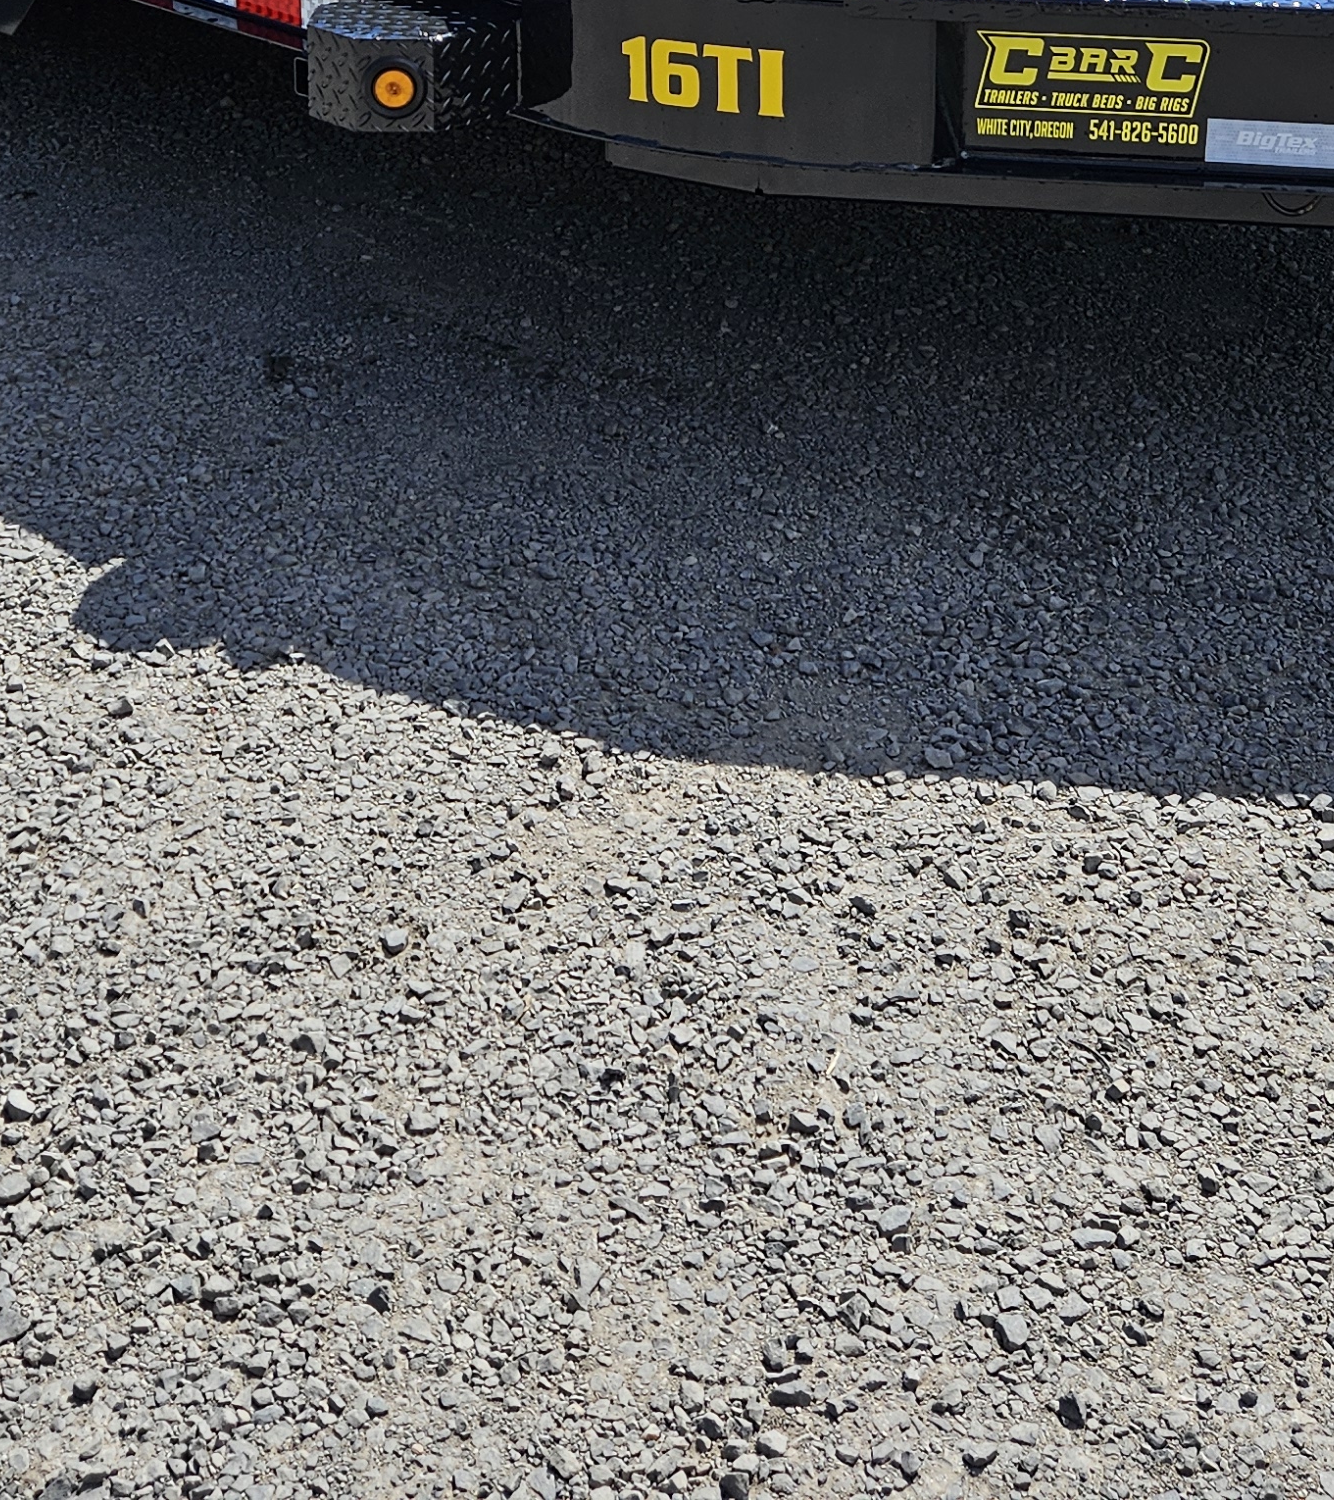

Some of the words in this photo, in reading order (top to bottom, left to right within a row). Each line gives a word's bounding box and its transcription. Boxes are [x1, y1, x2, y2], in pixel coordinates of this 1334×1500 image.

[621, 35, 785, 118] 16TI
[988, 35, 1045, 86] C
[1050, 46, 1139, 70] BAR
[1145, 42, 1204, 93] C
[984, 88, 1040, 105] TRAILERS
[1051, 91, 1090, 108] TRUCK
[1092, 94, 1124, 110] BEDS
[1135, 96, 1157, 112] BIG
[1160, 97, 1190, 113] RIGS
[977, 117, 1009, 136] WHITE
[1089, 119, 1199, 145] 541-826-5600
[1236, 130, 1319, 152] BigTex
[1273, 146, 1317, 156] TRAILERS
